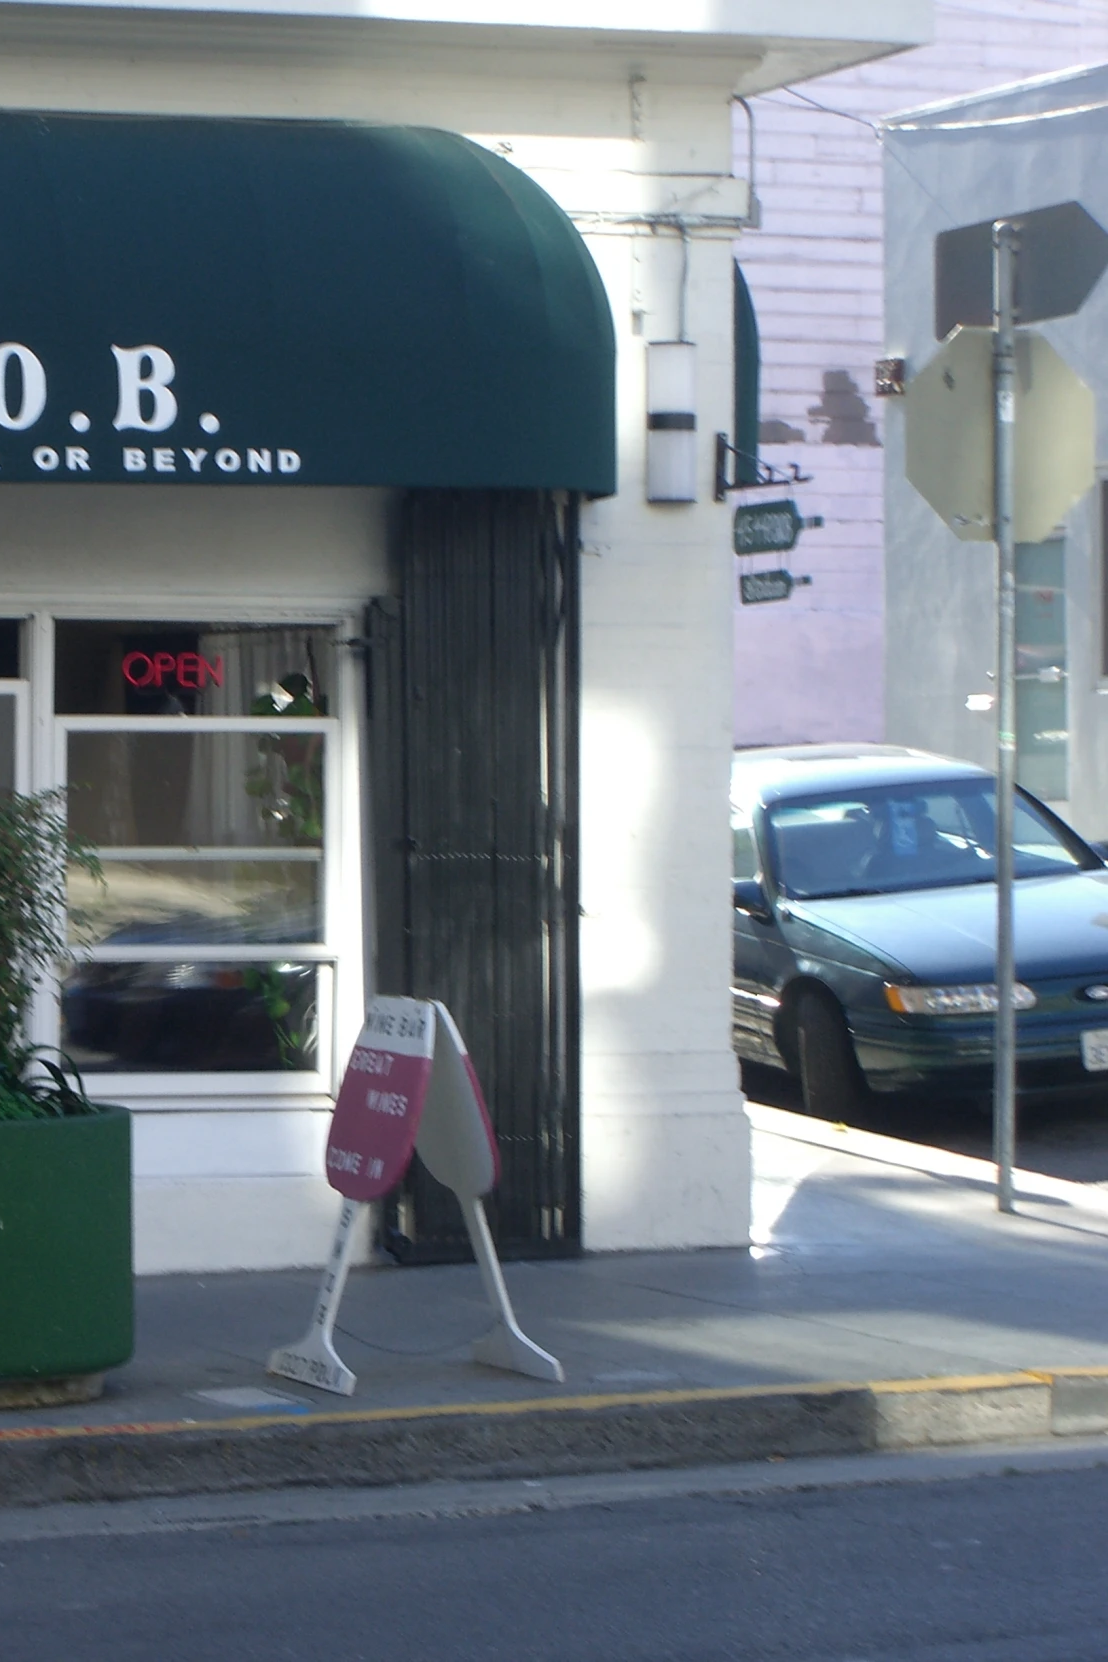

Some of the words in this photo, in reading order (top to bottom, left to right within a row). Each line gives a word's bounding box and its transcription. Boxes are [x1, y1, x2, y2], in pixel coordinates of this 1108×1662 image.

[32, 446, 92, 472] OR
[123, 447, 303, 474] BEYOND
[122, 650, 224, 689] OPEN
